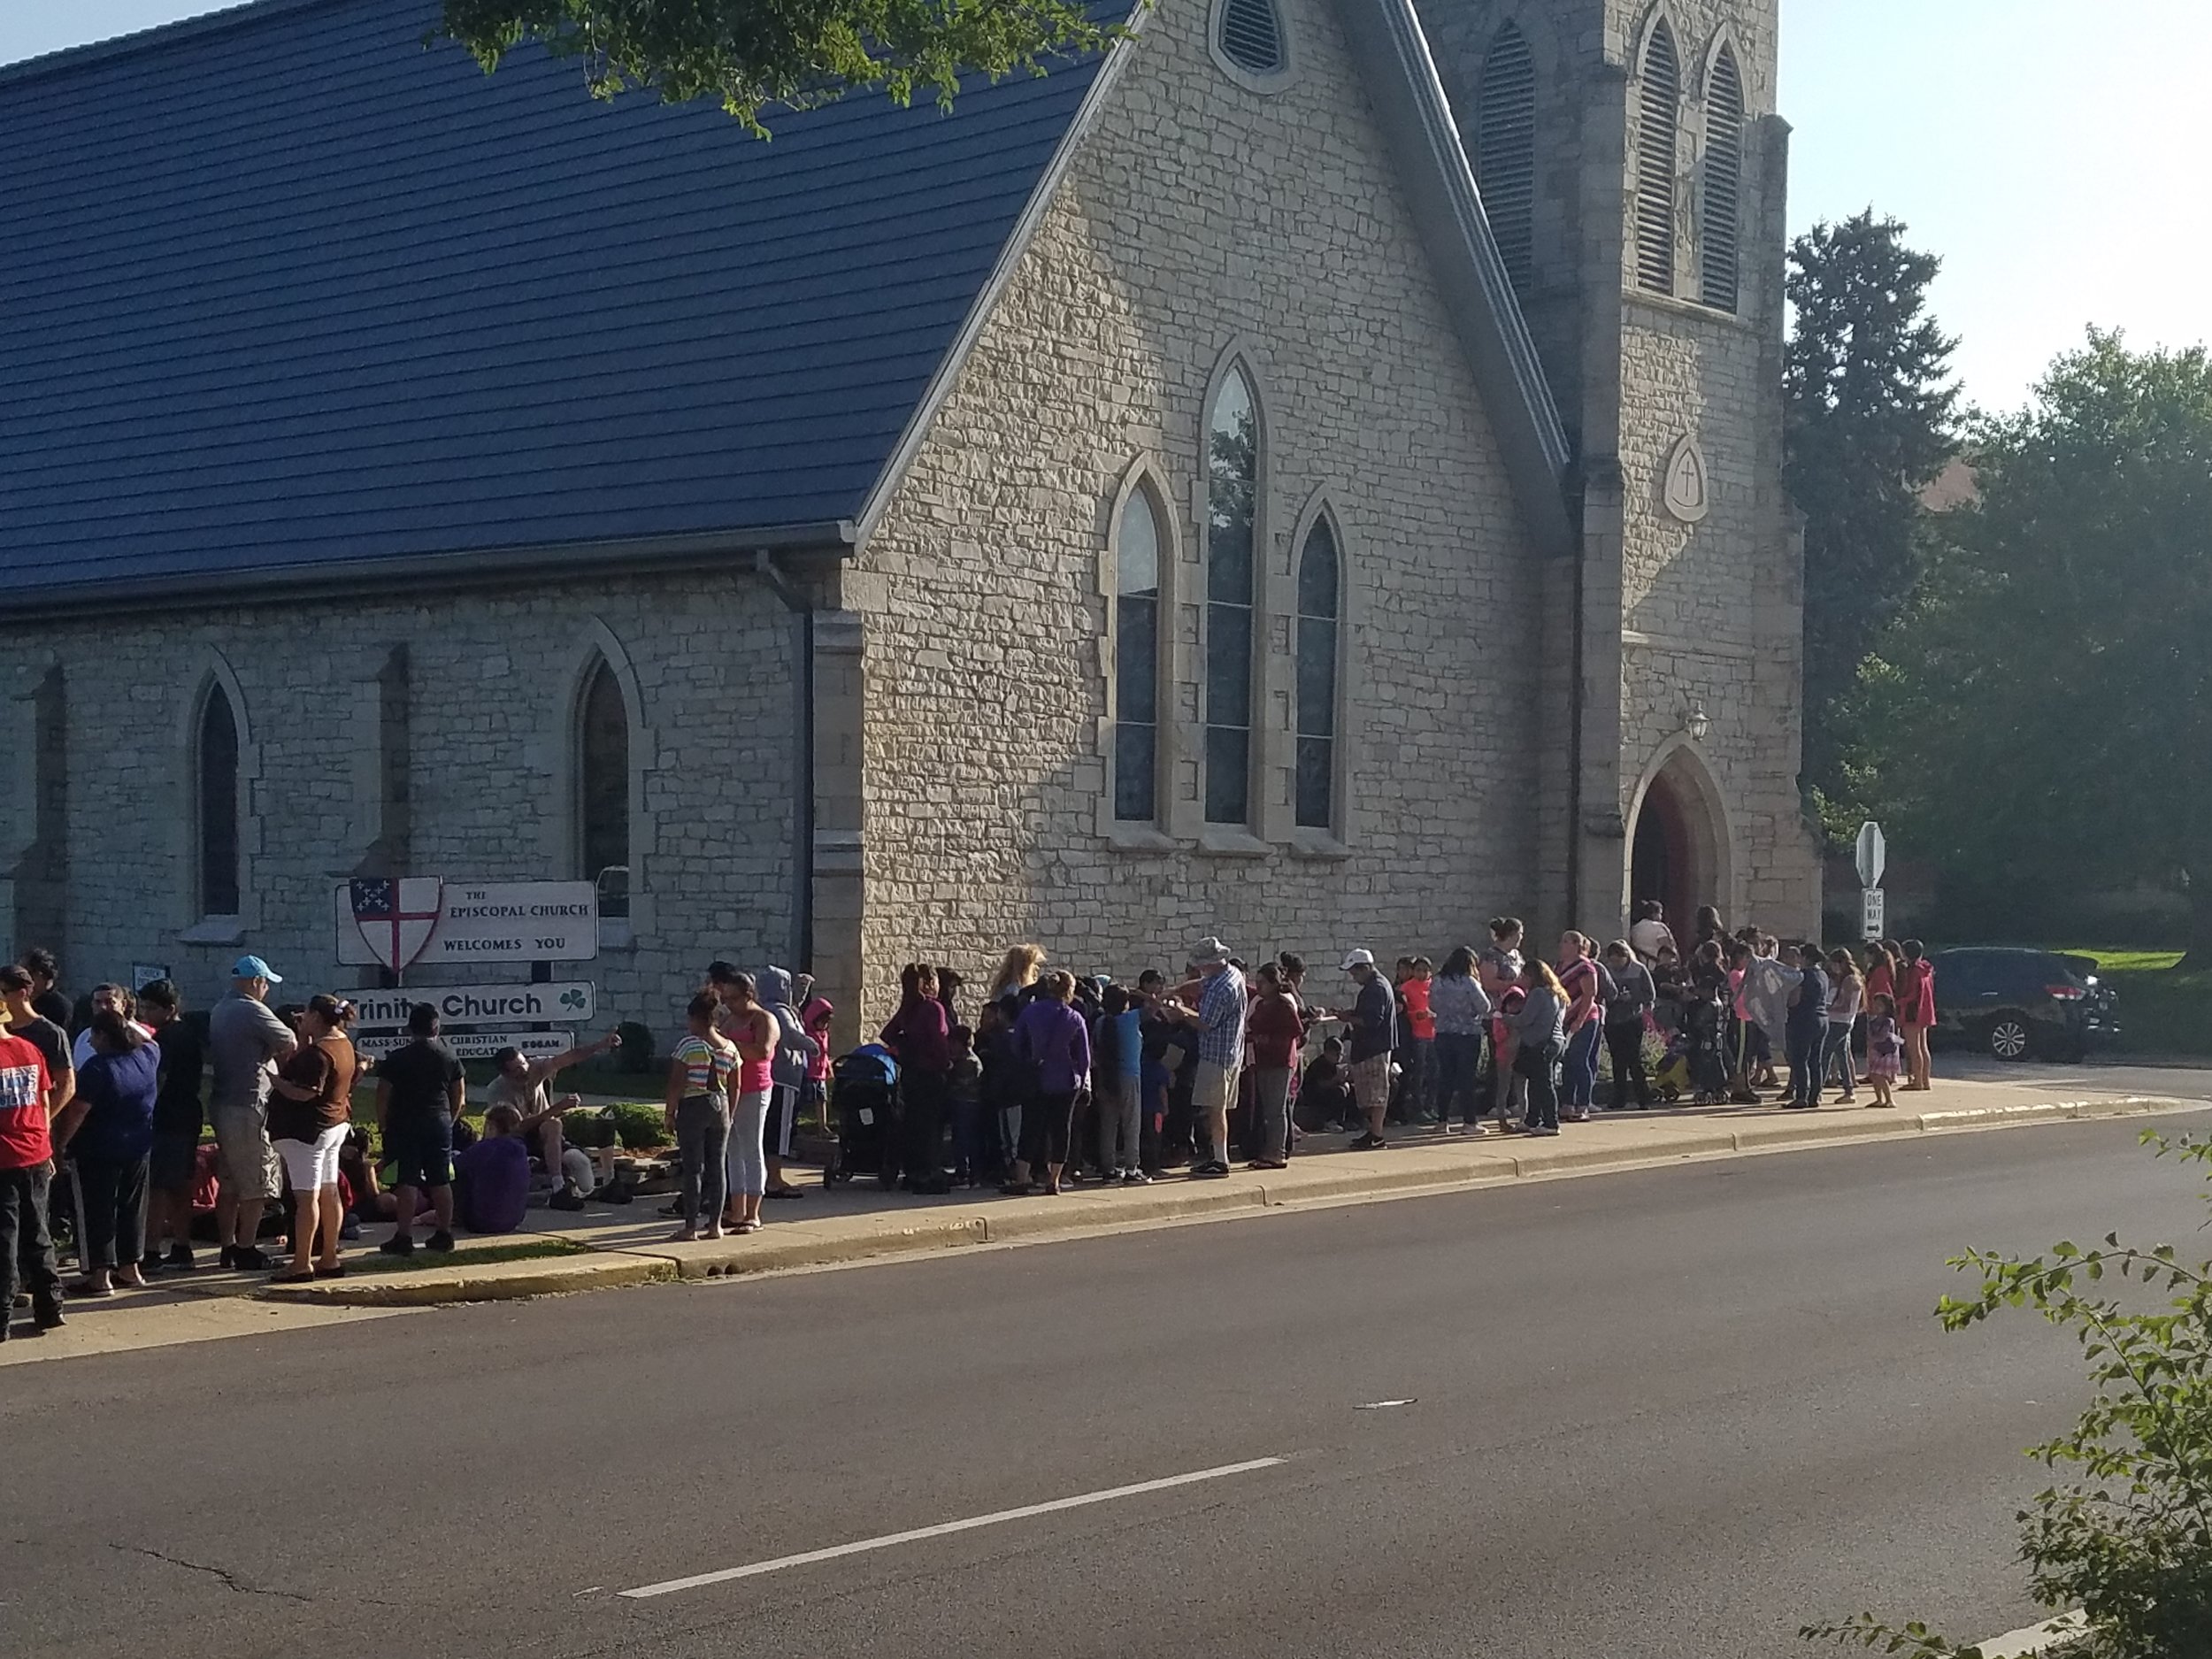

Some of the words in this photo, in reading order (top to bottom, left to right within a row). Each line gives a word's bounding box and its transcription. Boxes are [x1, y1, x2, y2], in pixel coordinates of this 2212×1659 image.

[1867, 894, 1882, 907] ONE
[449, 905, 526, 918] EPISCOPAL
[530, 904, 588, 917] CHURCH
[1867, 909, 1882, 919] WAY
[443, 939, 522, 951] WELCOMES
[534, 937, 565, 949] YOU
[442, 993, 541, 1017] Church
[449, 1035, 508, 1045] CHRISTIAN
[456, 1046, 500, 1056] EDUCAT
